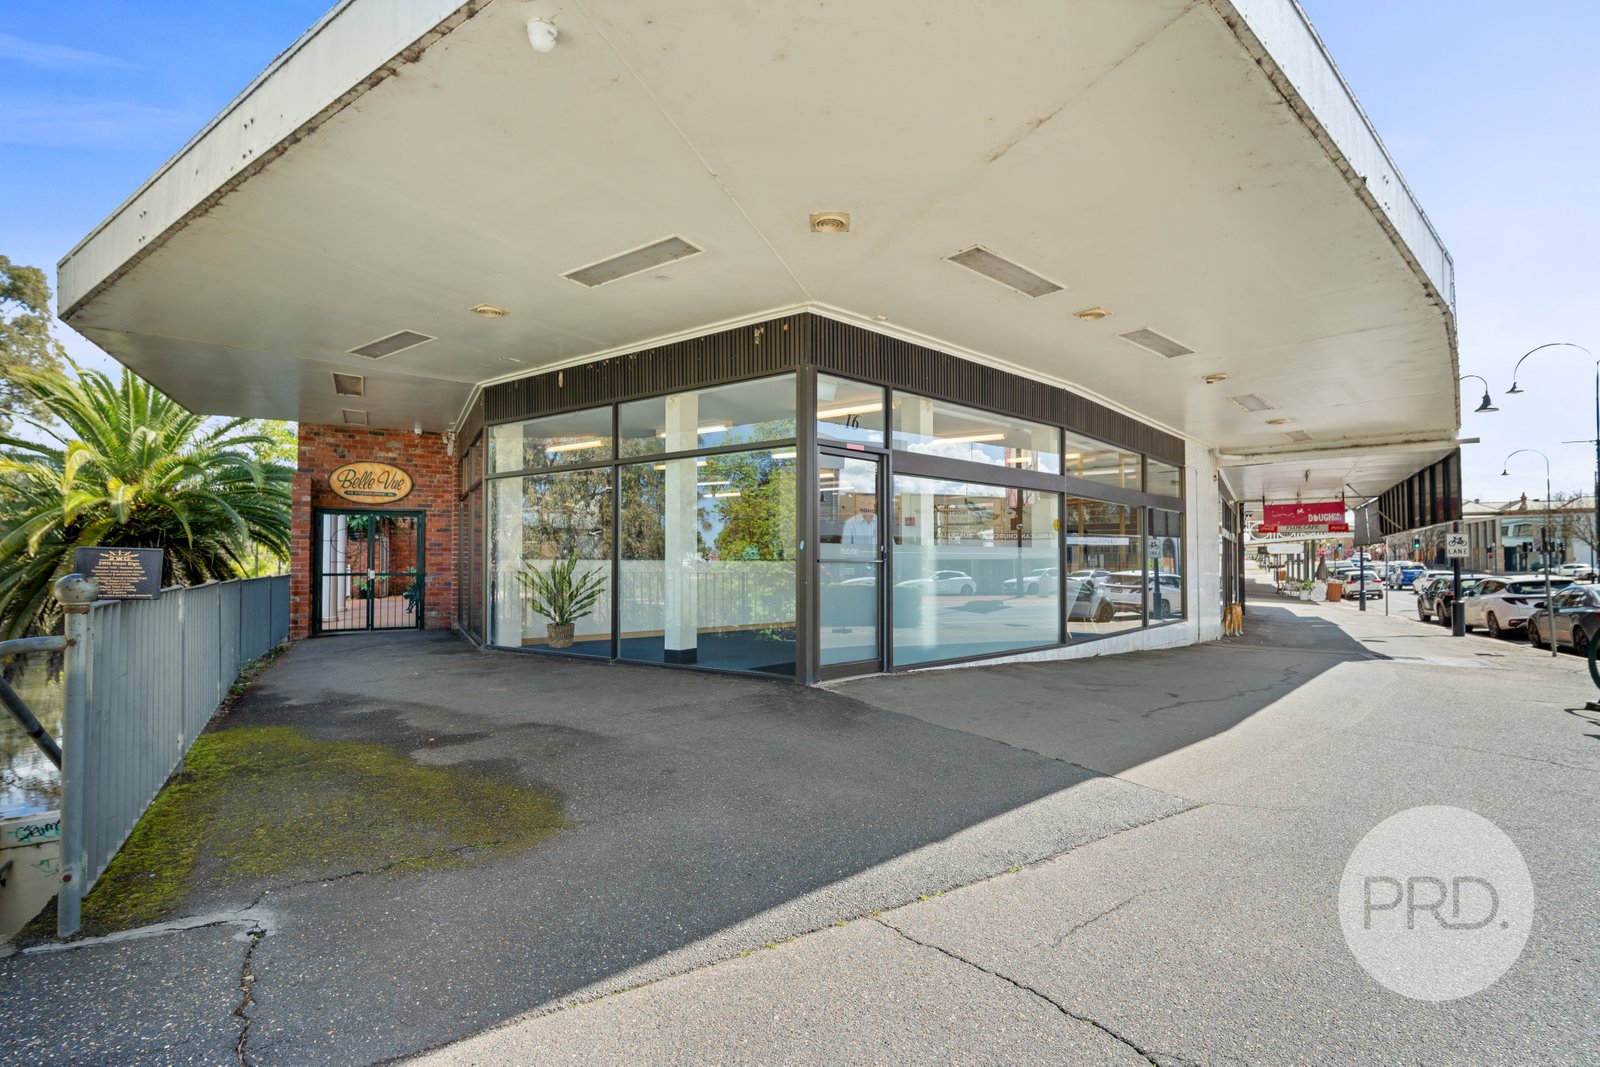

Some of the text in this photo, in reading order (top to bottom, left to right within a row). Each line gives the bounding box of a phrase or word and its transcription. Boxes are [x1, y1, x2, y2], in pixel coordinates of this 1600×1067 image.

[846, 414, 860, 430] 16
[337, 469, 404, 490] Belle Vue
